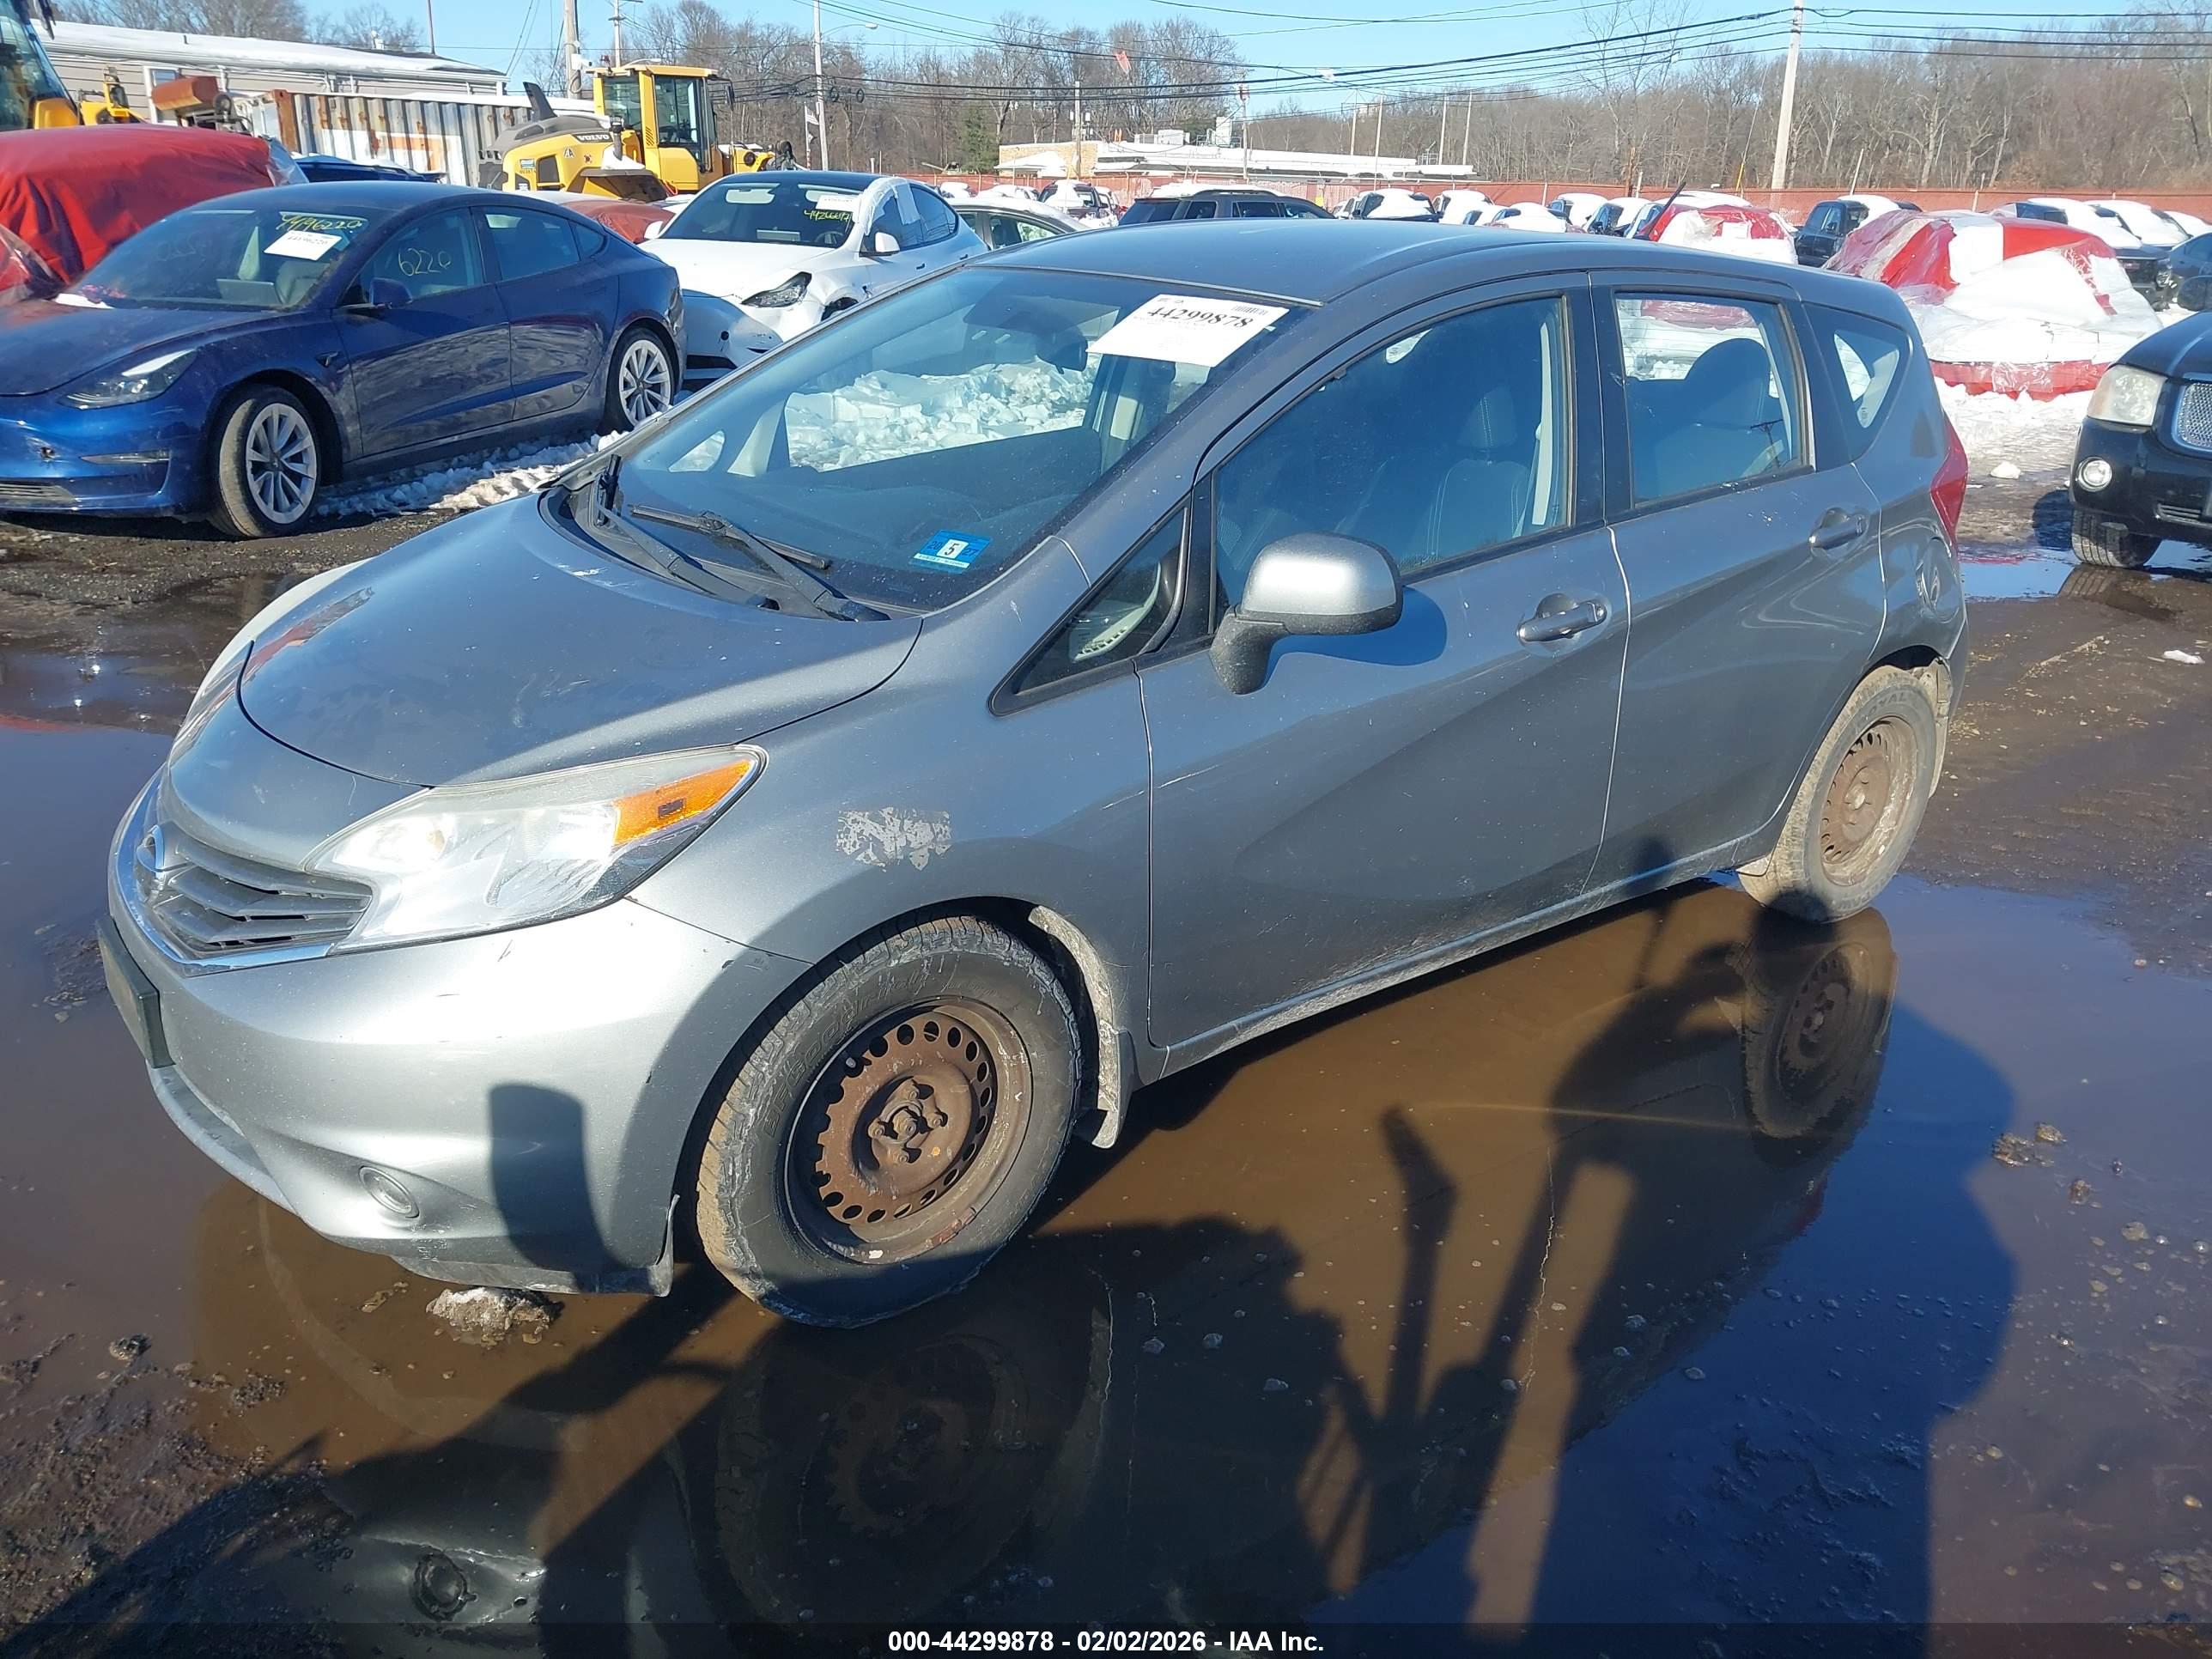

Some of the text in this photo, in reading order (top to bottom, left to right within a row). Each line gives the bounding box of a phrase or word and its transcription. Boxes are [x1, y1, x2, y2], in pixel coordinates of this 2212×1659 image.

[398, 247, 452, 276] 6220
[1147, 307, 1255, 328] 44299878
[944, 543, 960, 556] 5
